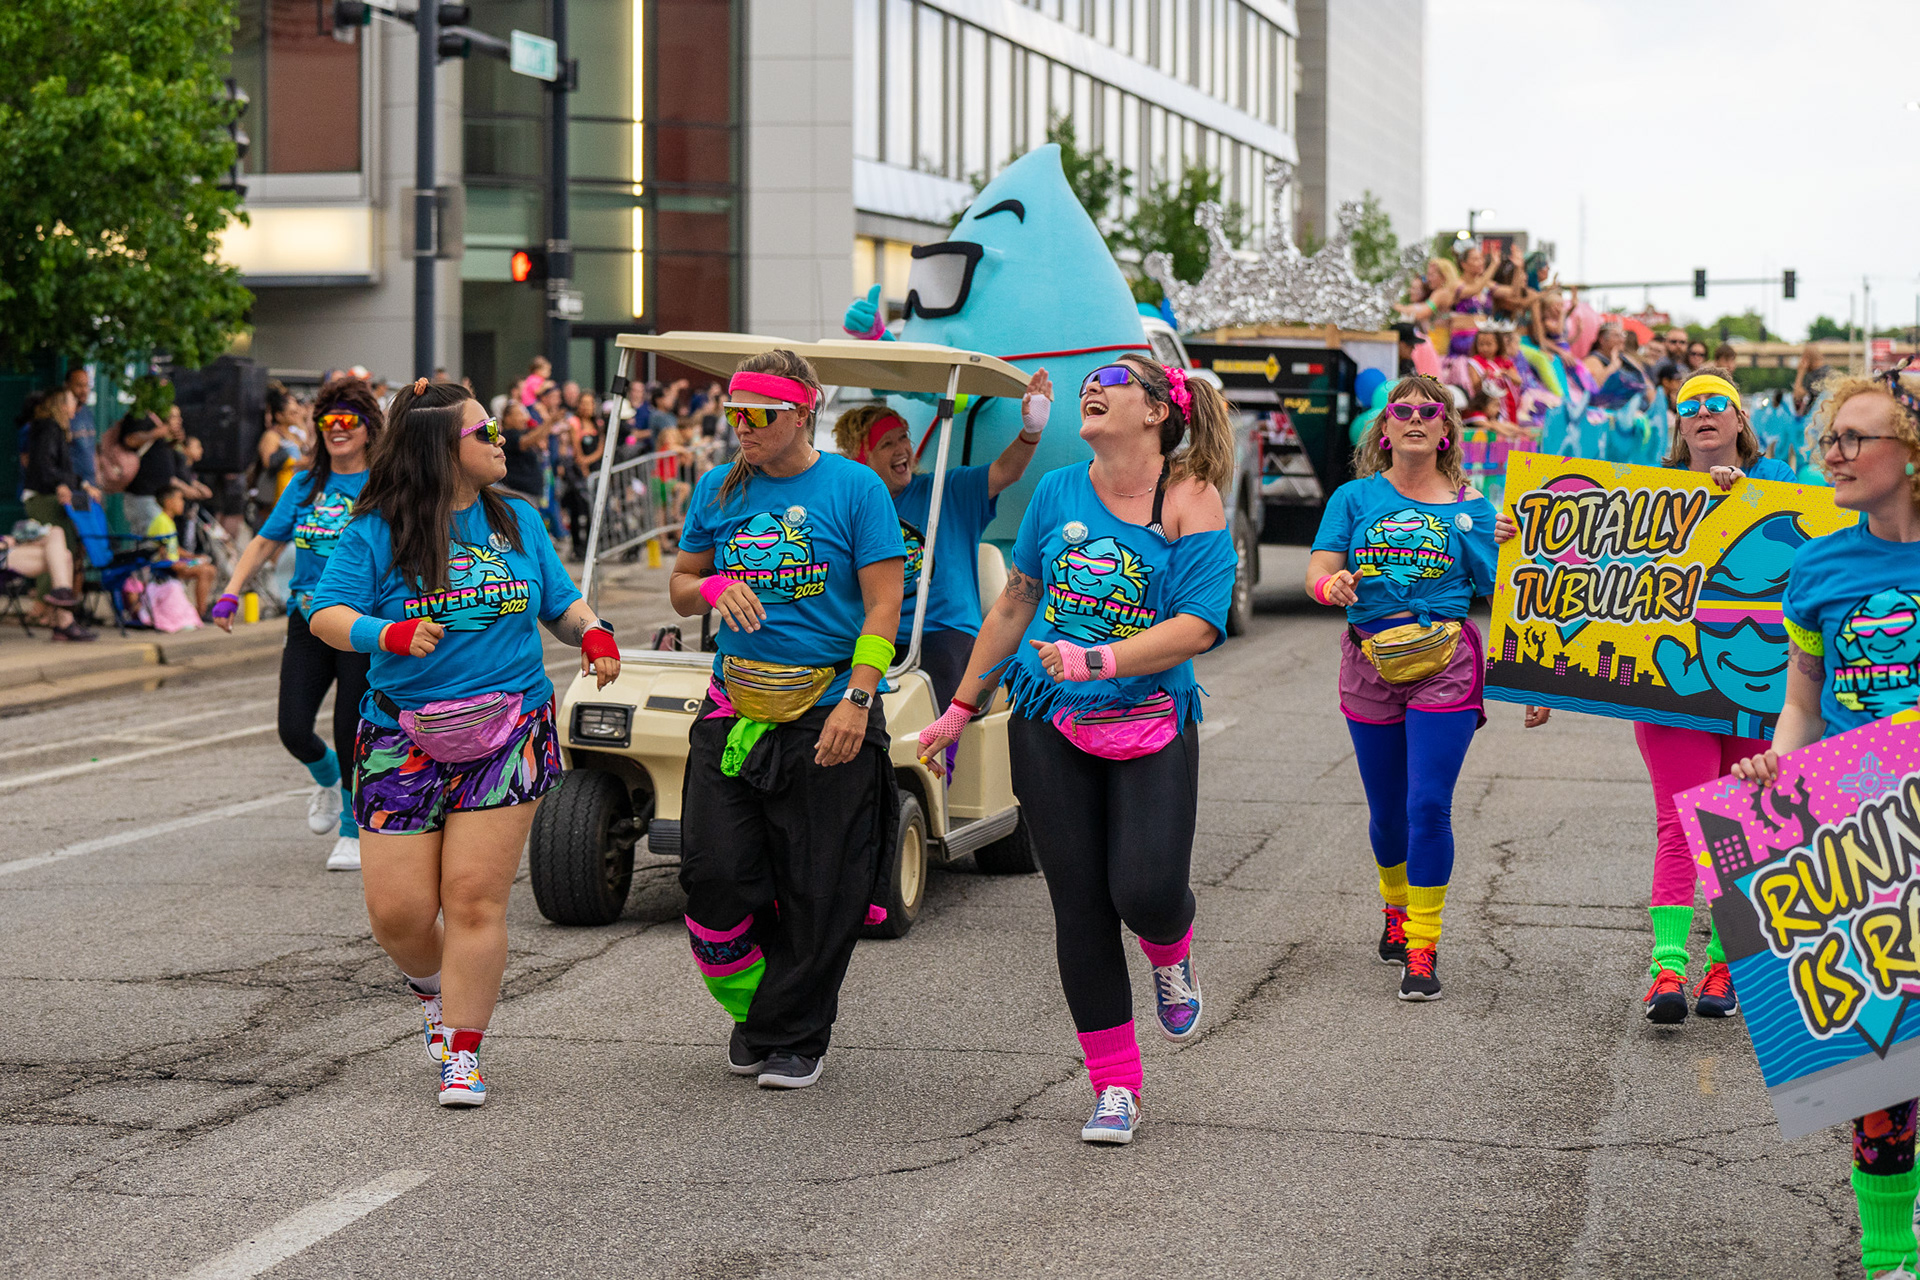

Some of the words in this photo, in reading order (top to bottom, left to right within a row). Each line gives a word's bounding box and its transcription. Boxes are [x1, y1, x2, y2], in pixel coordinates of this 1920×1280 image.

[1522, 493, 1704, 556] TOTALLY
[1354, 547, 1414, 566] RIVER
[1416, 549, 1455, 572] RUN
[779, 562, 829, 589] RUN
[404, 587, 478, 619] RIVER
[483, 580, 530, 604] RUN
[793, 581, 825, 600] 2023
[1516, 568, 1699, 620] TUBULAR!
[499, 598, 528, 615] 2023
[1101, 600, 1157, 628] RUN
[1832, 663, 1910, 692] RIVER
[1799, 939, 1860, 1028] IS
